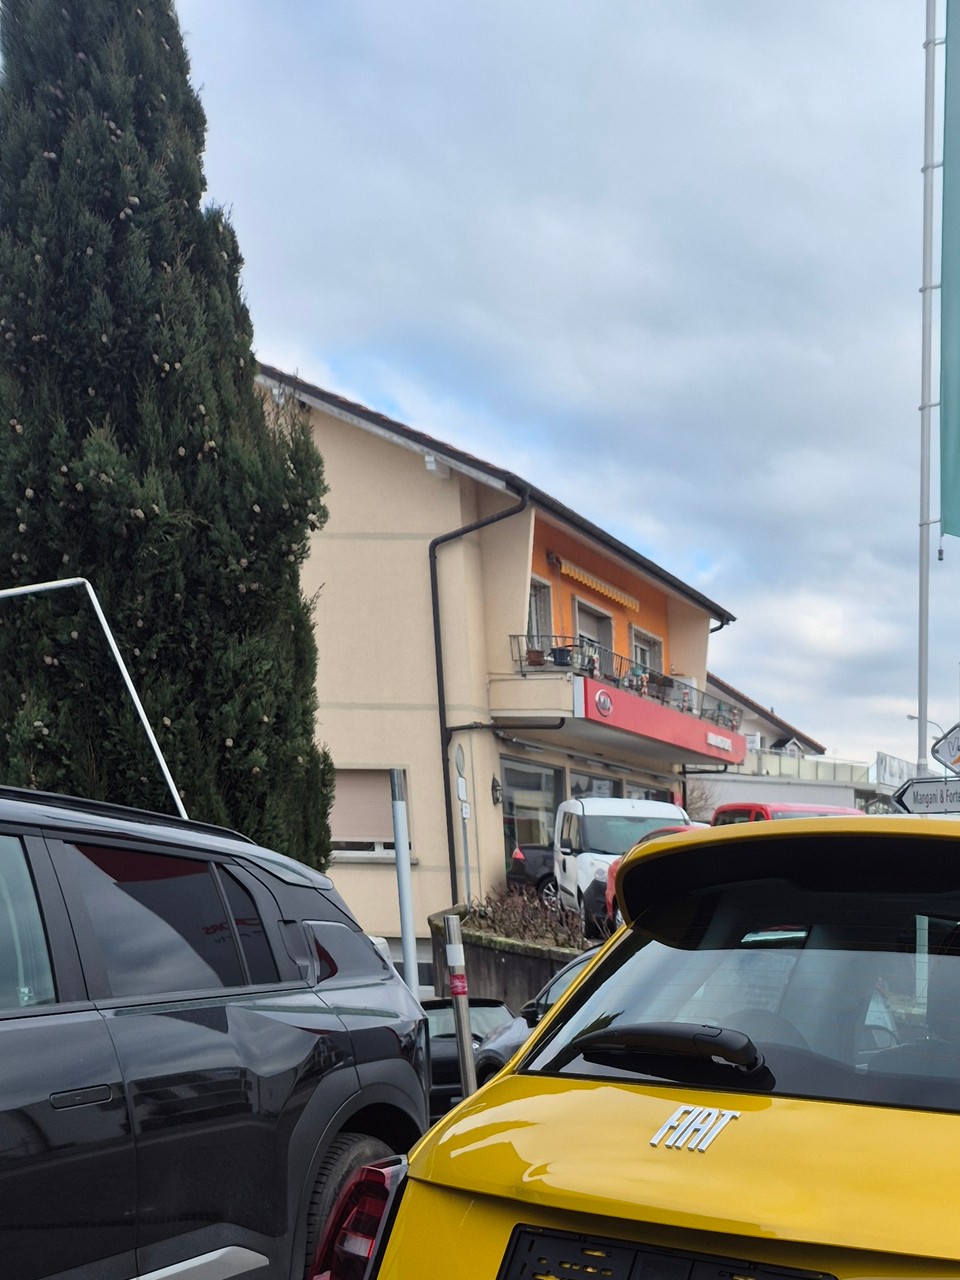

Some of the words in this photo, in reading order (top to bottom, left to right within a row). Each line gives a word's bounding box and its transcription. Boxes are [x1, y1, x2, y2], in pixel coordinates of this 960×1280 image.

[912, 789, 938, 808] Mangani
[939, 789, 944, 803] &
[650, 1105, 742, 1153] FIAT
